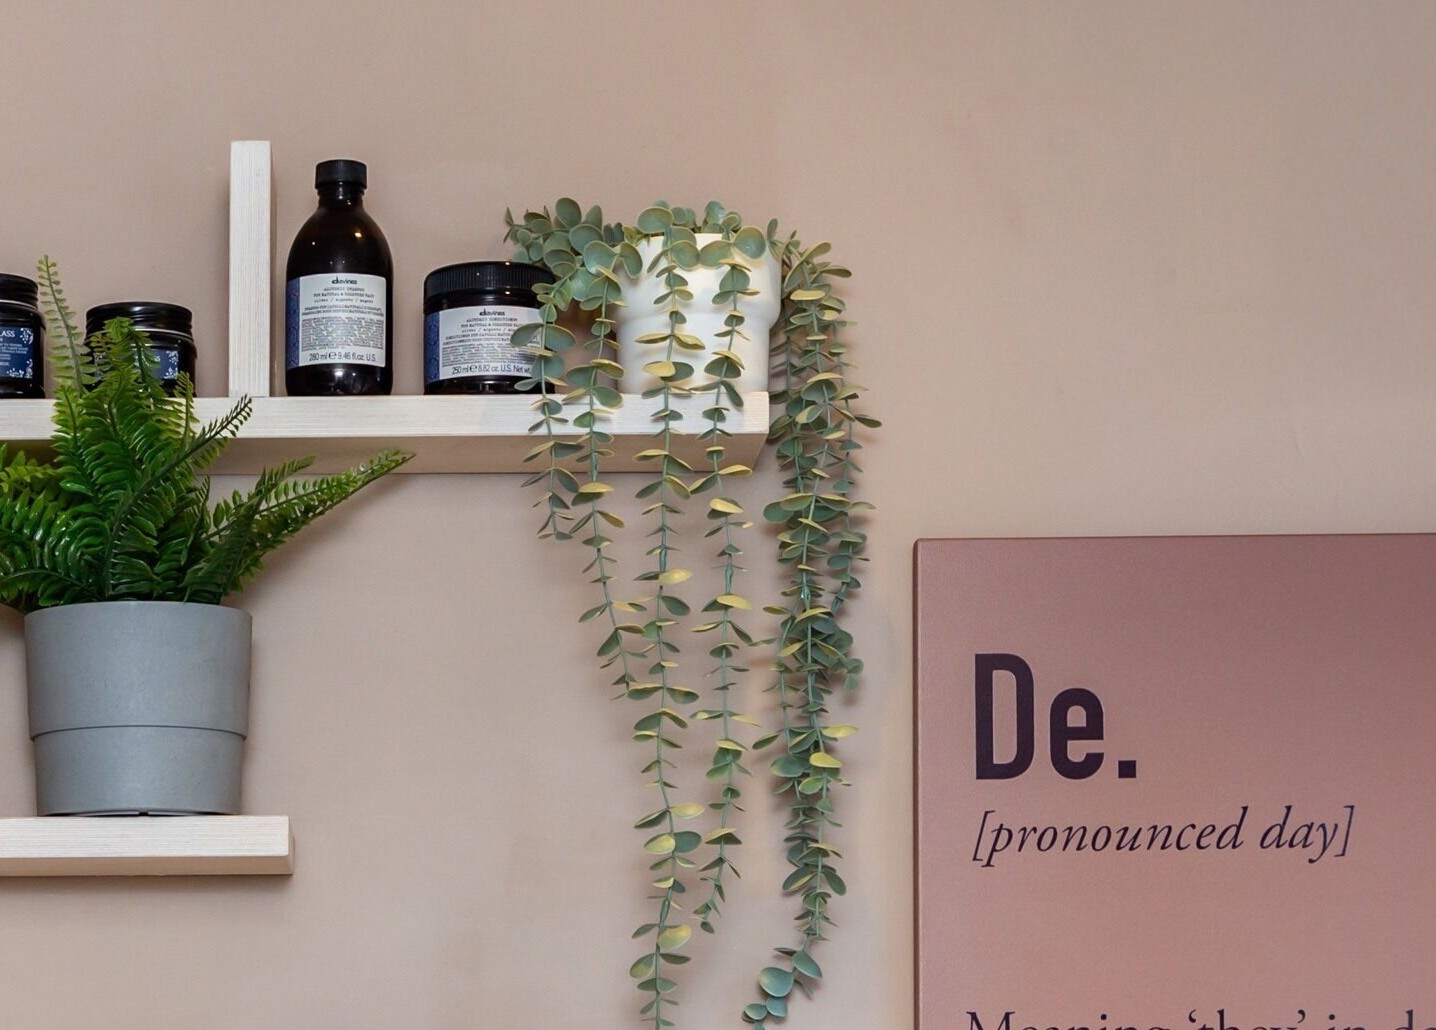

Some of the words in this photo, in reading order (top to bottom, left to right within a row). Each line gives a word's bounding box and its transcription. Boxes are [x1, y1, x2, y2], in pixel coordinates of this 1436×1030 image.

[331, 276, 357, 285] davines
[974, 652, 1137, 781] De.
[971, 805, 1249, 868] [pronounced
[1259, 804, 1356, 865] day]
